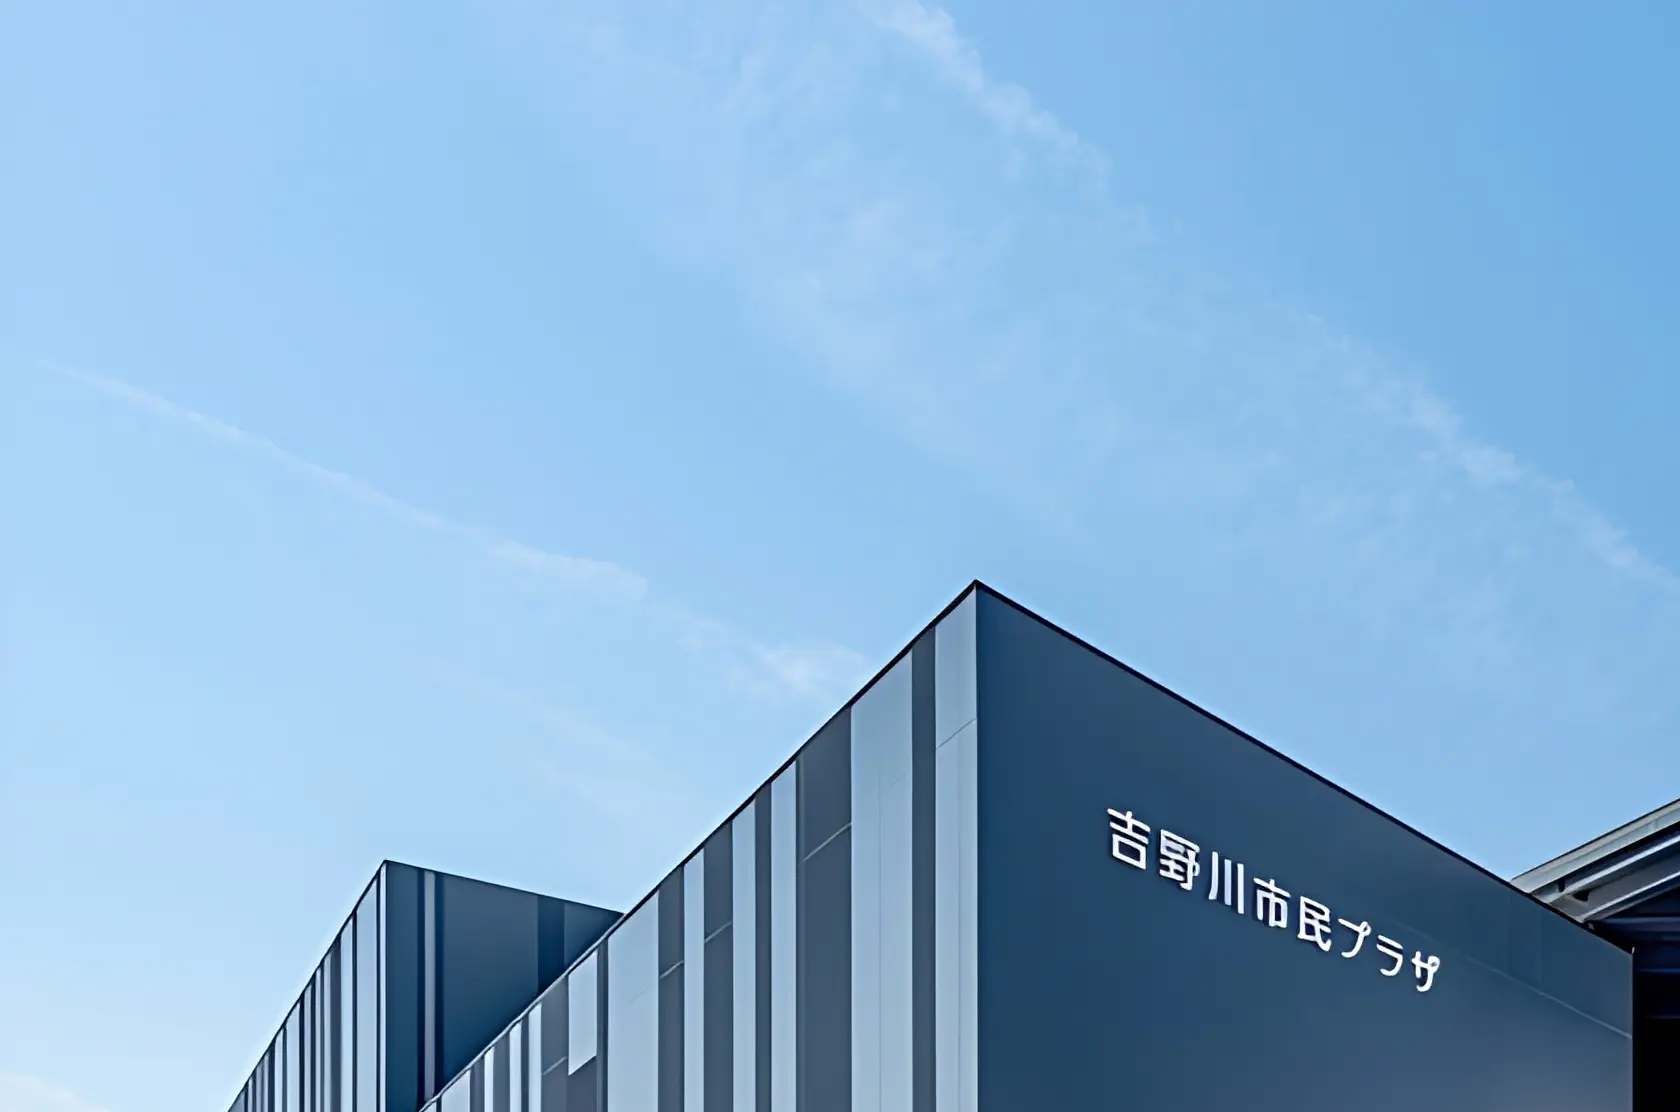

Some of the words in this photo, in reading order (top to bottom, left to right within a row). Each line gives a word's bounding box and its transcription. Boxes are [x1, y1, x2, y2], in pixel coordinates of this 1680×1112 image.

[1107, 808, 1441, 992] 吉野川市民プラザ
